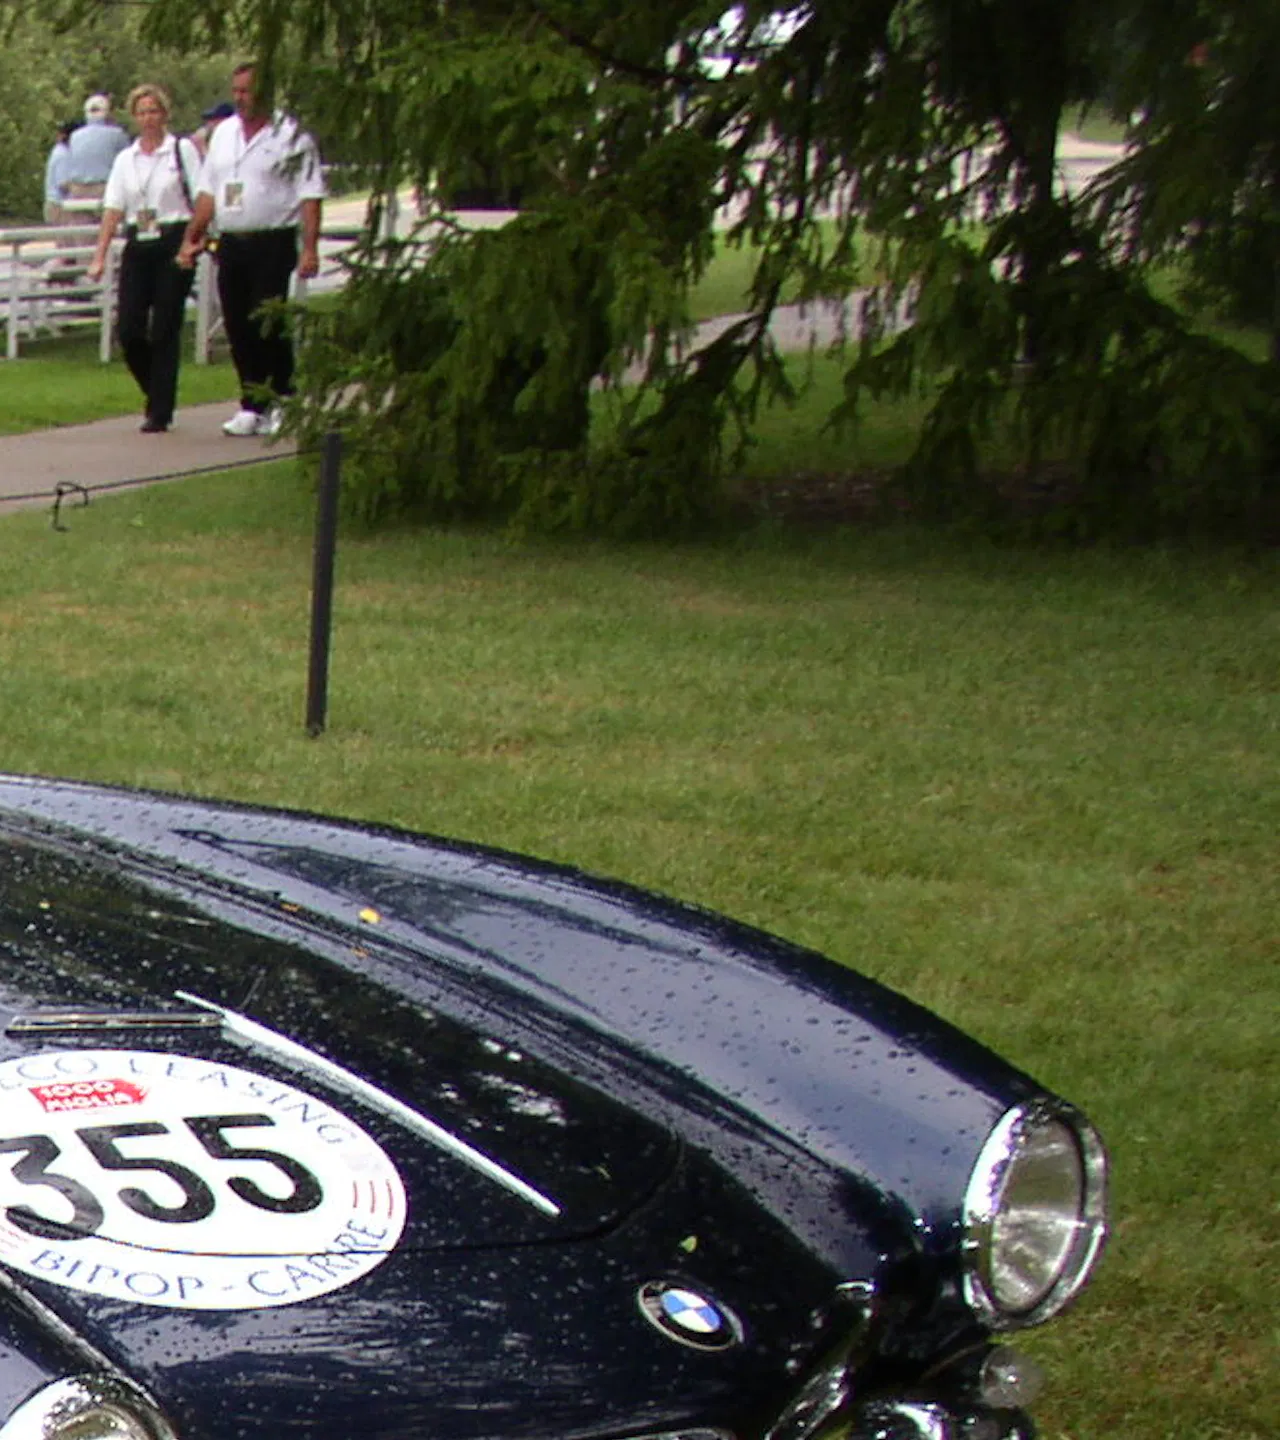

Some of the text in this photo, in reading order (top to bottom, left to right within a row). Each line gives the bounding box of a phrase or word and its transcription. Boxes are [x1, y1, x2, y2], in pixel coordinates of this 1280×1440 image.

[40, 1077, 116, 1099] 1000
[44, 1092, 135, 1113] MIGLIA
[128, 1056, 359, 1146] LEASING
